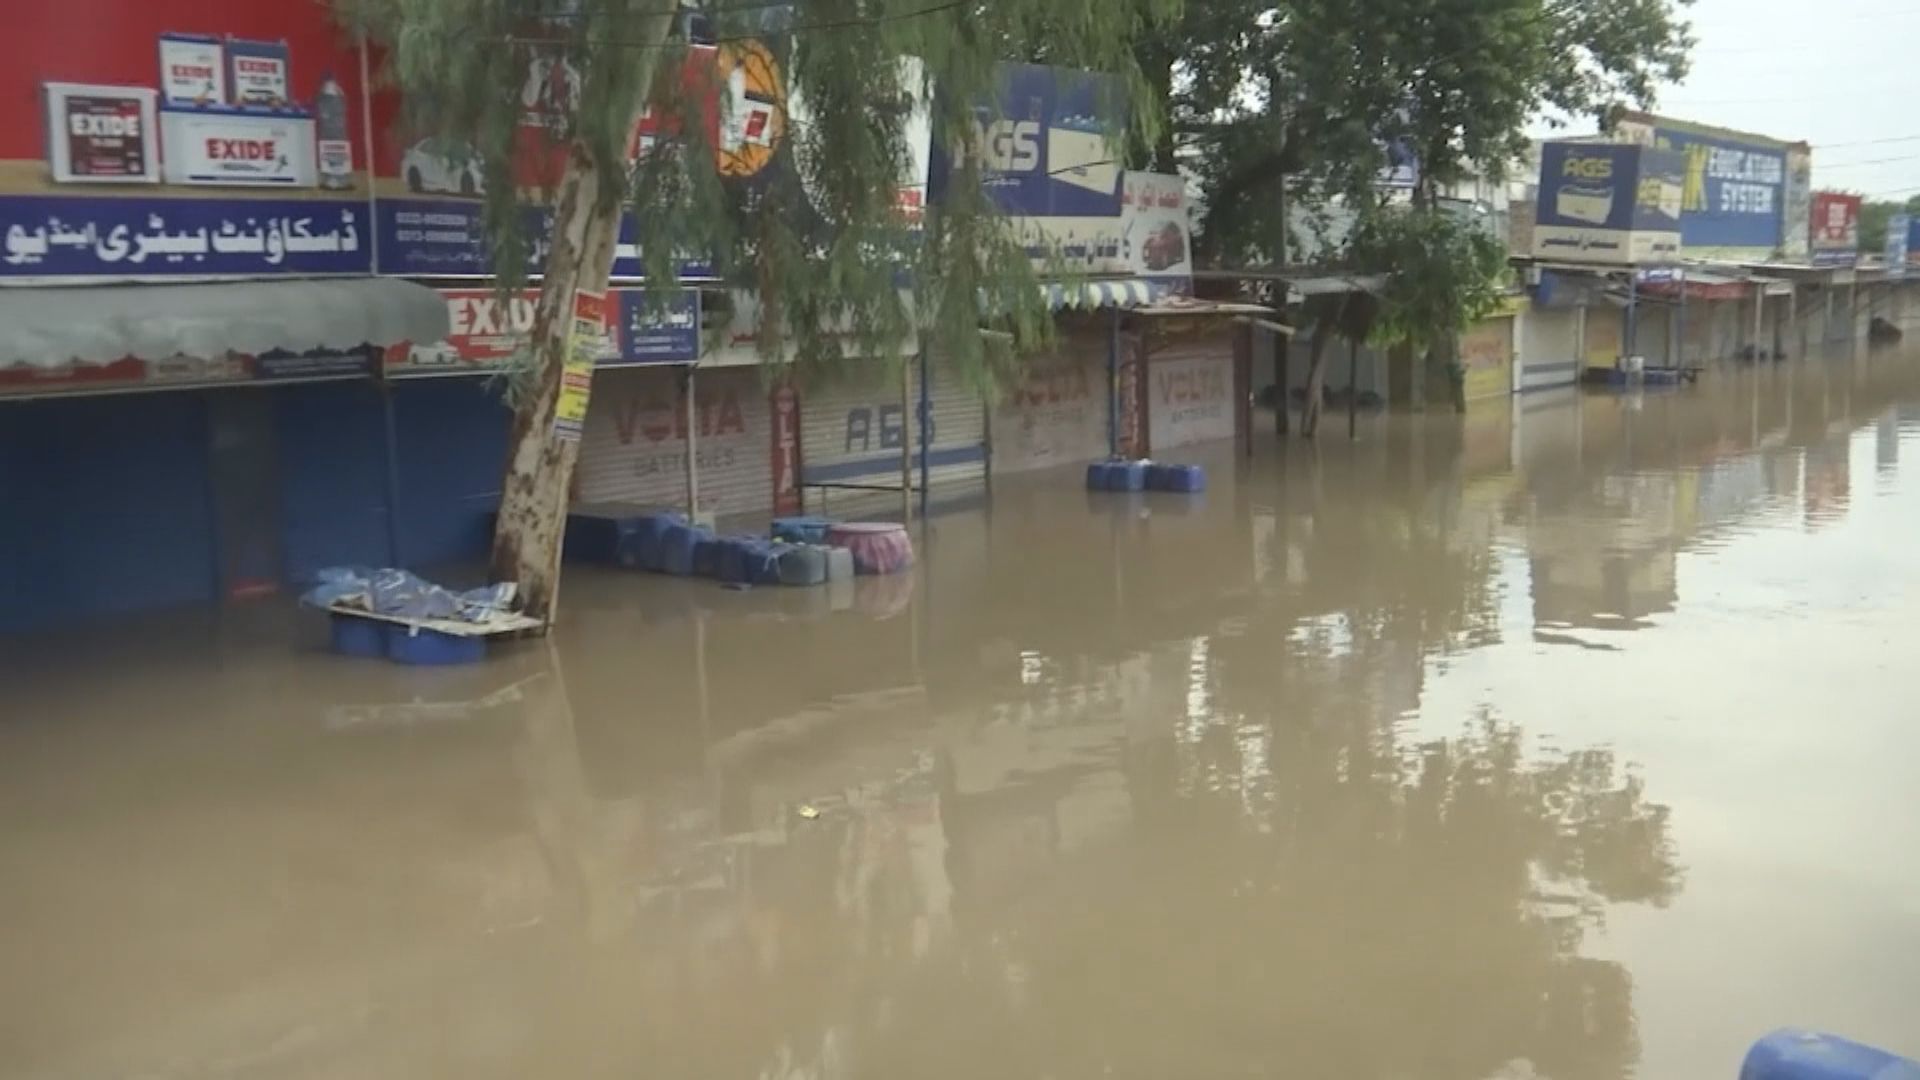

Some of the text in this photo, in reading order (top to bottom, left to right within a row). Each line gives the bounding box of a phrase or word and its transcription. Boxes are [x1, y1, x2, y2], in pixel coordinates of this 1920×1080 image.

[171, 64, 213, 78] EXIDE
[69, 112, 140, 137] EXIDE
[206, 137, 275, 160] EXIDE
[1562, 158, 1614, 178] AGS
[1708, 145, 1783, 184] EDUCATION
[1720, 182, 1774, 213] SYSTEM
[97, 213, 209, 262] بیٹری
[212, 207, 360, 264] ڈسکاؤنٹ
